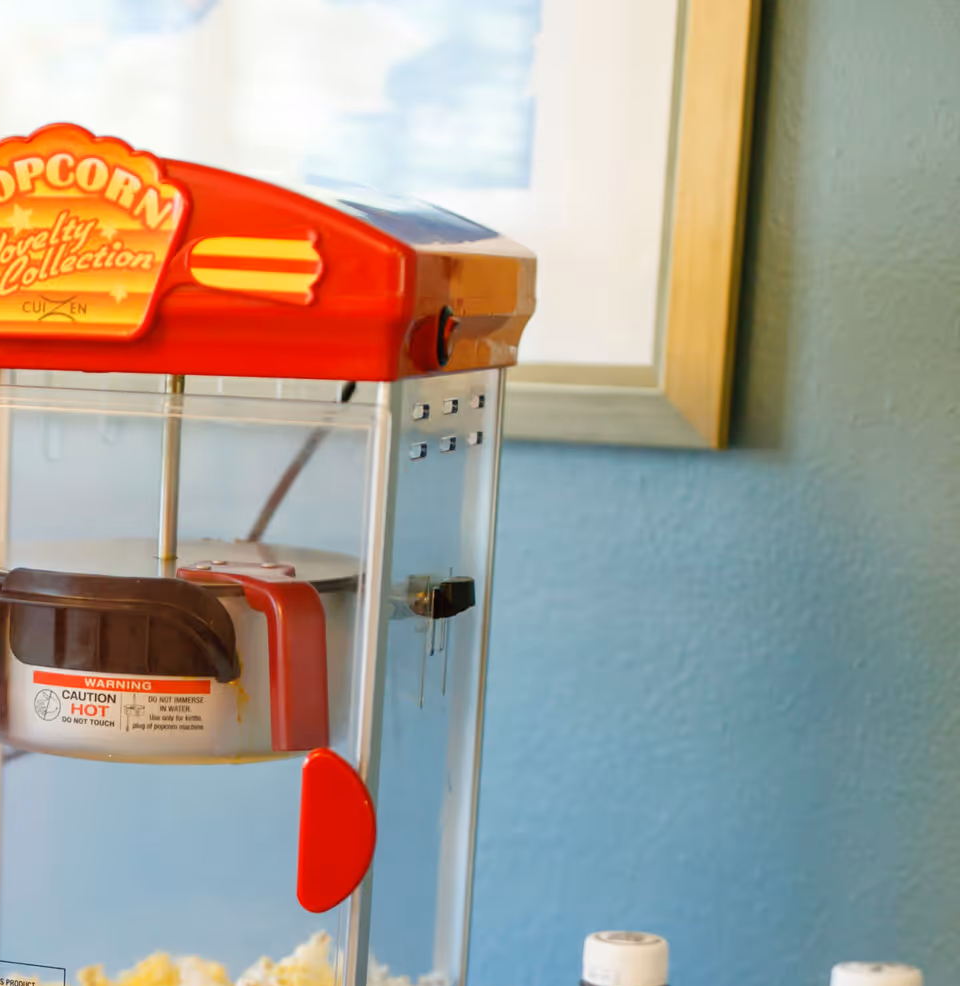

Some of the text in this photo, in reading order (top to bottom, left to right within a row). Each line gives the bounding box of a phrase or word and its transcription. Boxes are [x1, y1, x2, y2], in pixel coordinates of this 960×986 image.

[84, 678, 152, 691] WARNING
[61, 689, 117, 704] CAUTION
[148, 695, 158, 703] DO
[173, 696, 204, 704] IMMERSE
[70, 703, 110, 717] HOT
[61, 716, 115, 728] DO NOT TOUCH
